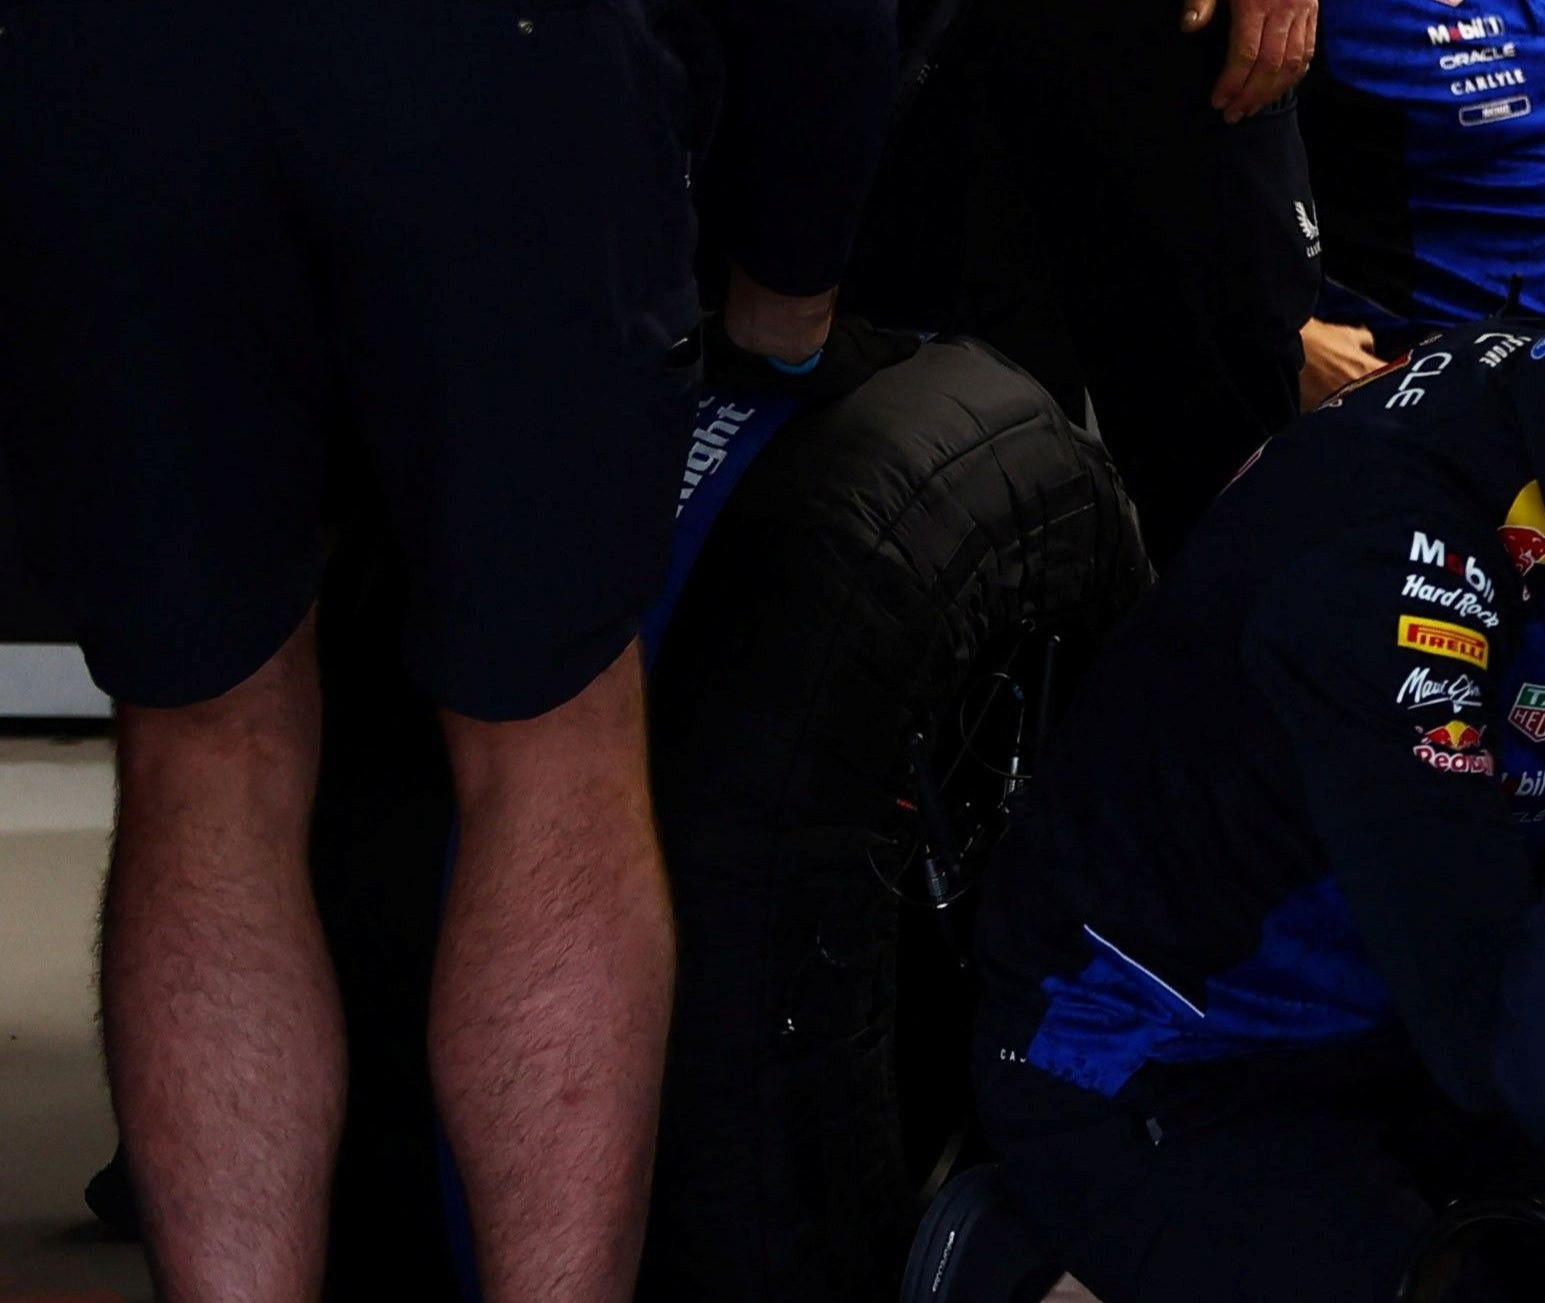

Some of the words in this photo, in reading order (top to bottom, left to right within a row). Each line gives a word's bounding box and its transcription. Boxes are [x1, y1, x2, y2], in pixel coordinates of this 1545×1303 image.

[1439, 42, 1516, 71] ORACLE
[1450, 67, 1527, 96] CARLYLE
[1402, 574, 1463, 607] Hard
[1454, 592, 1500, 628] Rock
[1407, 623, 1487, 662] PIRELLI
[1397, 666, 1449, 704] Maui
